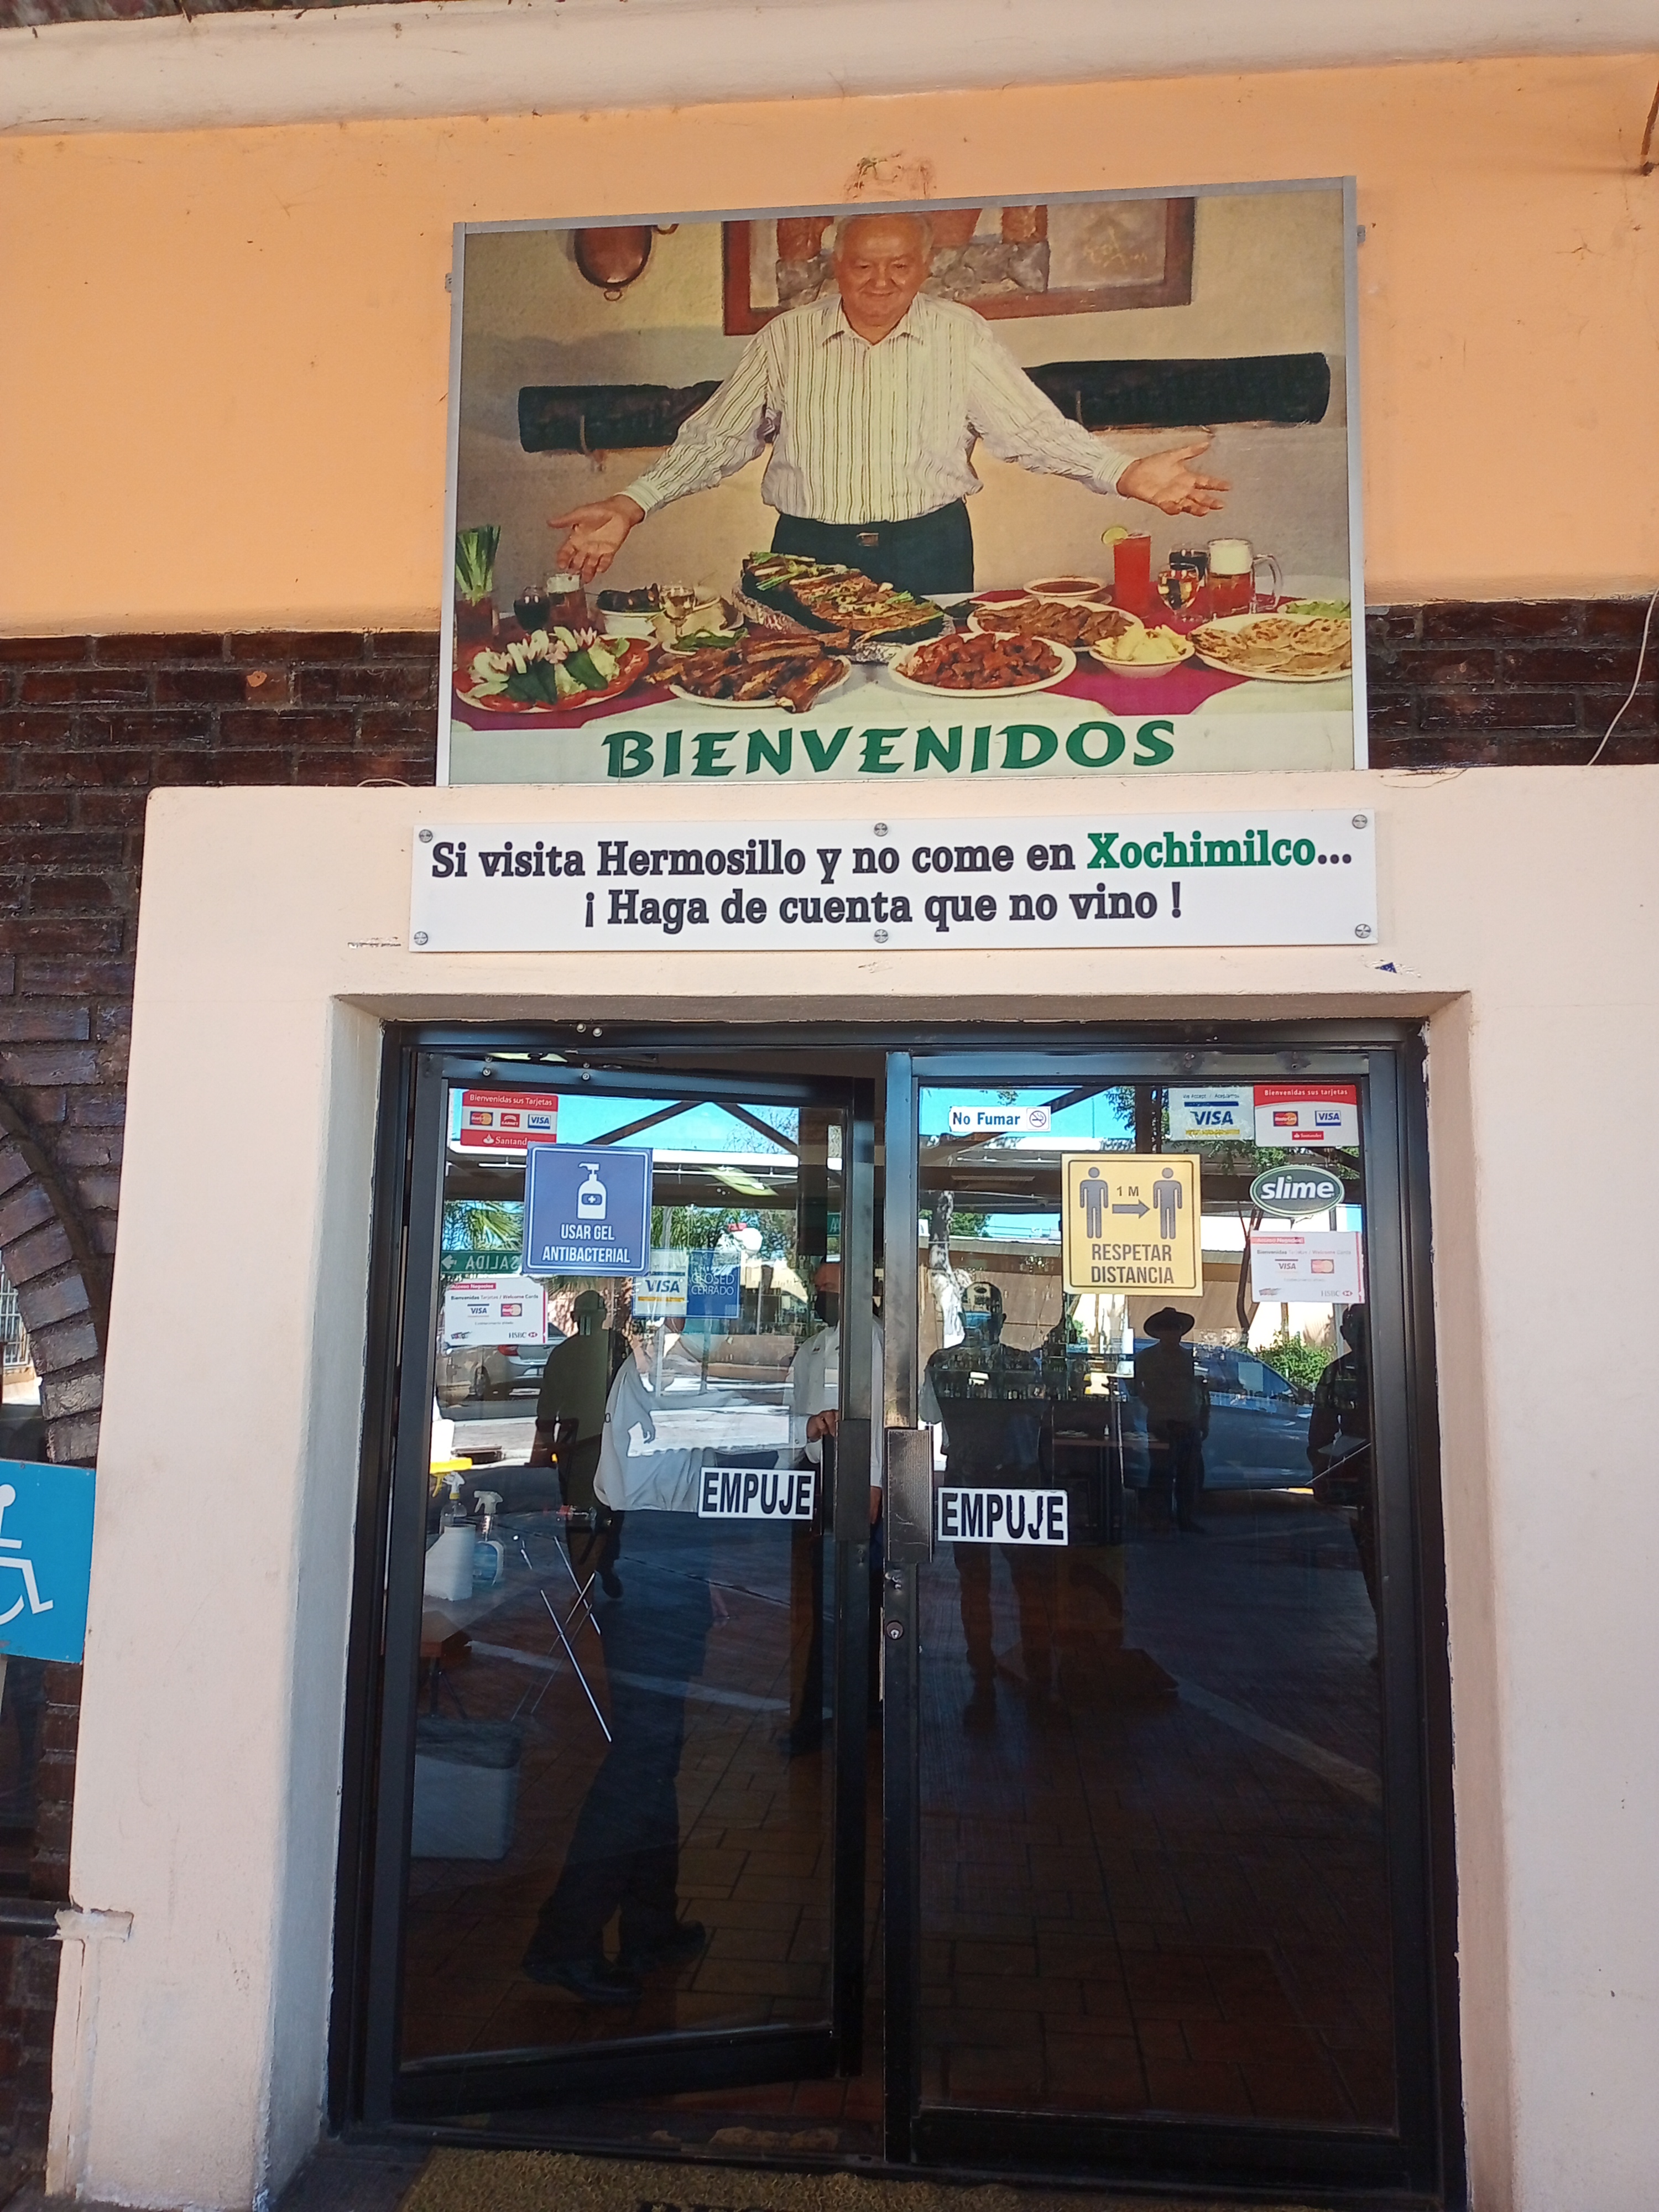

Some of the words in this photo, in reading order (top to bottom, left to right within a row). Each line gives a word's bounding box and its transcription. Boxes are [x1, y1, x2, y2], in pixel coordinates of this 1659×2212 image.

[602, 721, 1175, 778] BIENVENIDOS
[432, 842, 467, 877] Si
[479, 841, 585, 877] visita
[597, 839, 806, 876] Hermosillo
[817, 847, 842, 884] y
[853, 847, 899, 874] no
[912, 844, 1013, 873] come
[1027, 843, 1076, 871] en
[1087, 830, 1352, 869] Xochimilco...
[608, 889, 708, 935] Haga
[721, 889, 767, 923] de
[779, 891, 912, 923] cuenta
[925, 893, 997, 932] que
[1009, 893, 1057, 922] no
[1069, 883, 1157, 920] vino
[469, 1094, 512, 1104] Bienvenidas
[525, 1097, 552, 1107] Tarjetas
[953, 1112, 971, 1125] No
[977, 1112, 1020, 1125] Fumar
[1190, 1111, 1233, 1125] VISA
[1318, 1113, 1340, 1121] VISA
[495, 1136, 535, 1146] Santand
[1117, 1186, 1122, 1196] 1
[1128, 1186, 1139, 1197] M
[1260, 1176, 1334, 1199] slime
[561, 1224, 591, 1239] USAR
[593, 1225, 615, 1240] GEL
[542, 1245, 630, 1263] ANTIBACTERIAL
[1092, 1243, 1172, 1261] RESPETAR
[1091, 1266, 1175, 1284] DISTANCIA
[645, 1280, 680, 1293] VISA
[691, 1286, 734, 1296] CERRADO
[701, 1471, 813, 1516] EMPUJE
[941, 1492, 1065, 1540] EMPUJE
